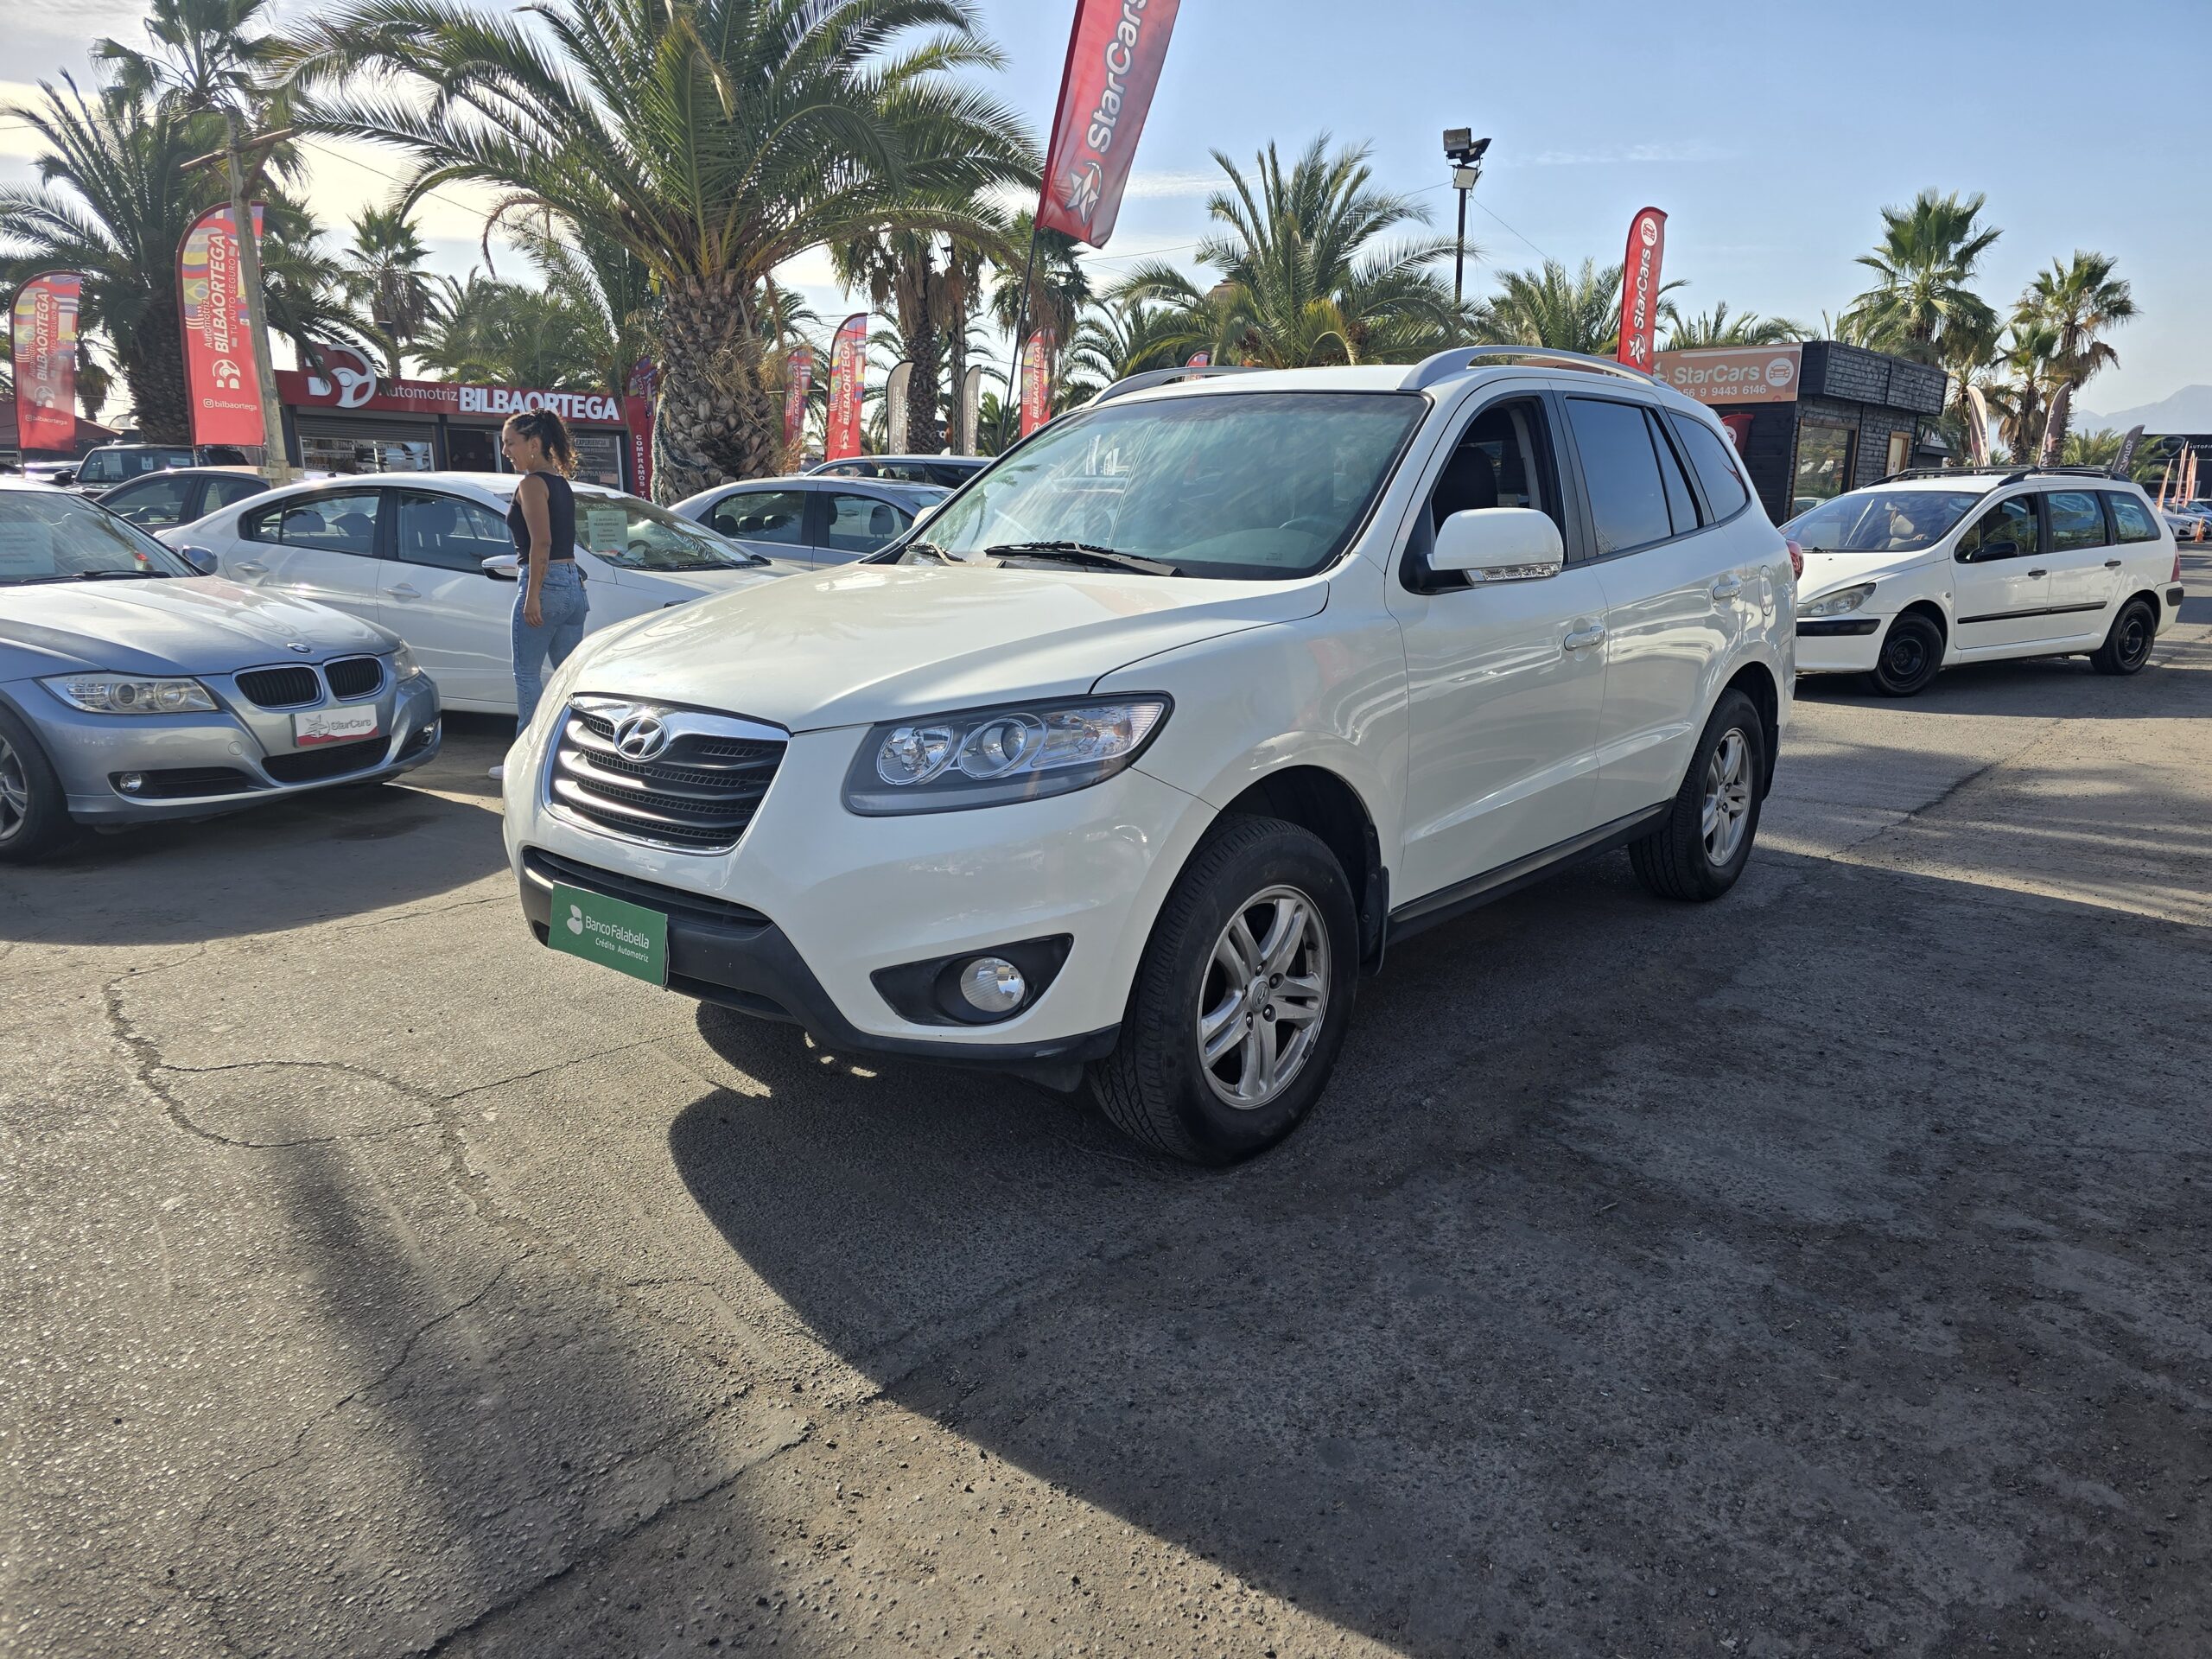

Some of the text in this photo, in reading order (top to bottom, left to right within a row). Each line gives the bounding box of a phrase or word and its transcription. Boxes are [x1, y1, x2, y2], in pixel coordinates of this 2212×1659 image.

[210, 236, 229, 353] BILBAORTEGA
[1634, 248, 1651, 329] StarCars
[36, 294, 50, 381] BILBAORTEGA
[203, 299, 213, 348] Automotriz
[230, 323, 238, 334] TU
[841, 340, 851, 425] BILBAORTEGA
[1674, 365, 1760, 385] StarCars
[214, 400, 257, 411] bilbaortega
[378, 385, 459, 402] utomotriz
[459, 386, 620, 421] BILBAORTEGA
[1700, 388, 1707, 397] 9
[1712, 386, 1738, 397] 9443
[1742, 385, 1766, 395] 6146
[636, 435, 645, 486] COMPRAMOS
[331, 719, 372, 730] StarCars
[595, 938, 649, 963] Crédito Automotriz
